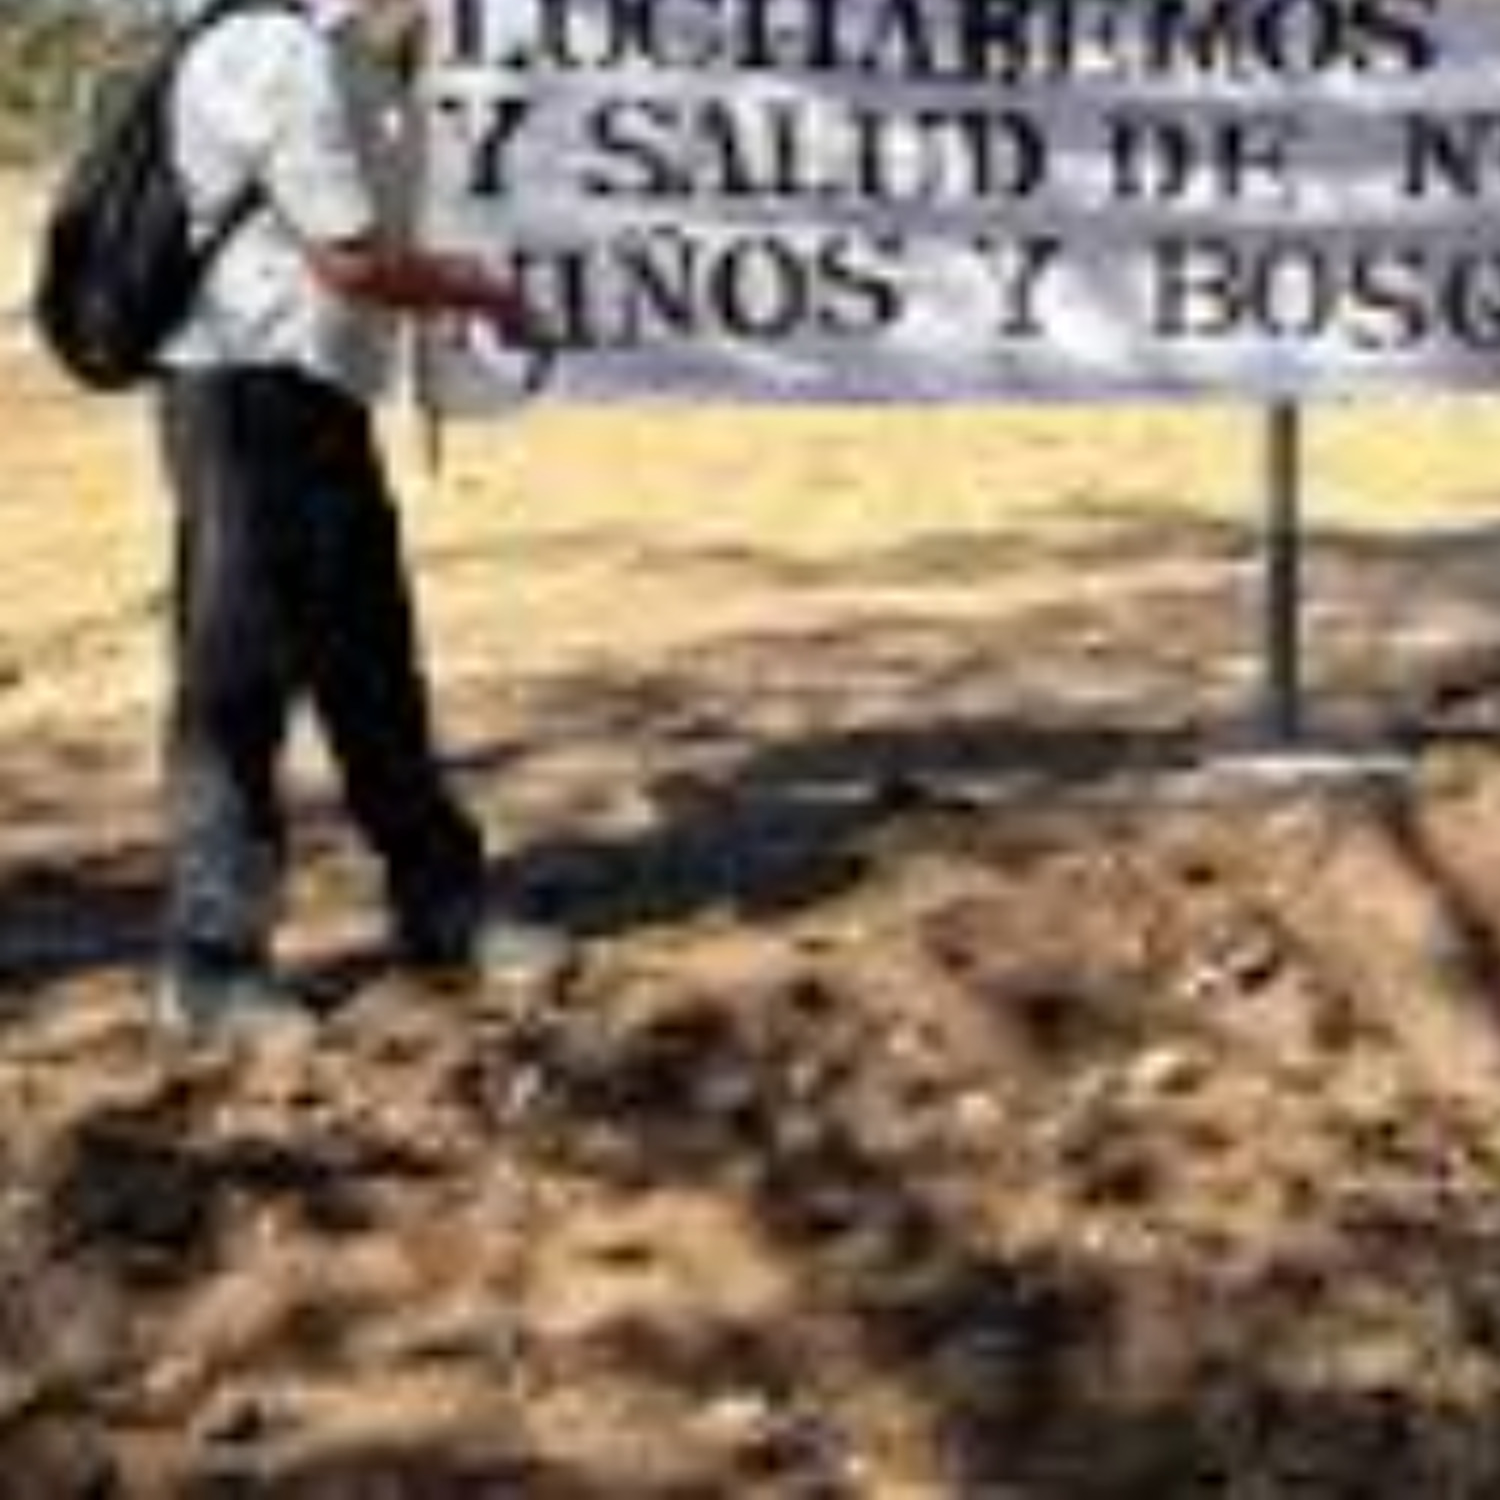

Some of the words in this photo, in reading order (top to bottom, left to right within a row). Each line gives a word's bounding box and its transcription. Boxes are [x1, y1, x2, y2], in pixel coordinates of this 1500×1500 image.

[437, 96, 534, 200] Y
[582, 98, 1048, 202] SALUD
[1105, 106, 1298, 200] DE
[974, 232, 1066, 340] Y
